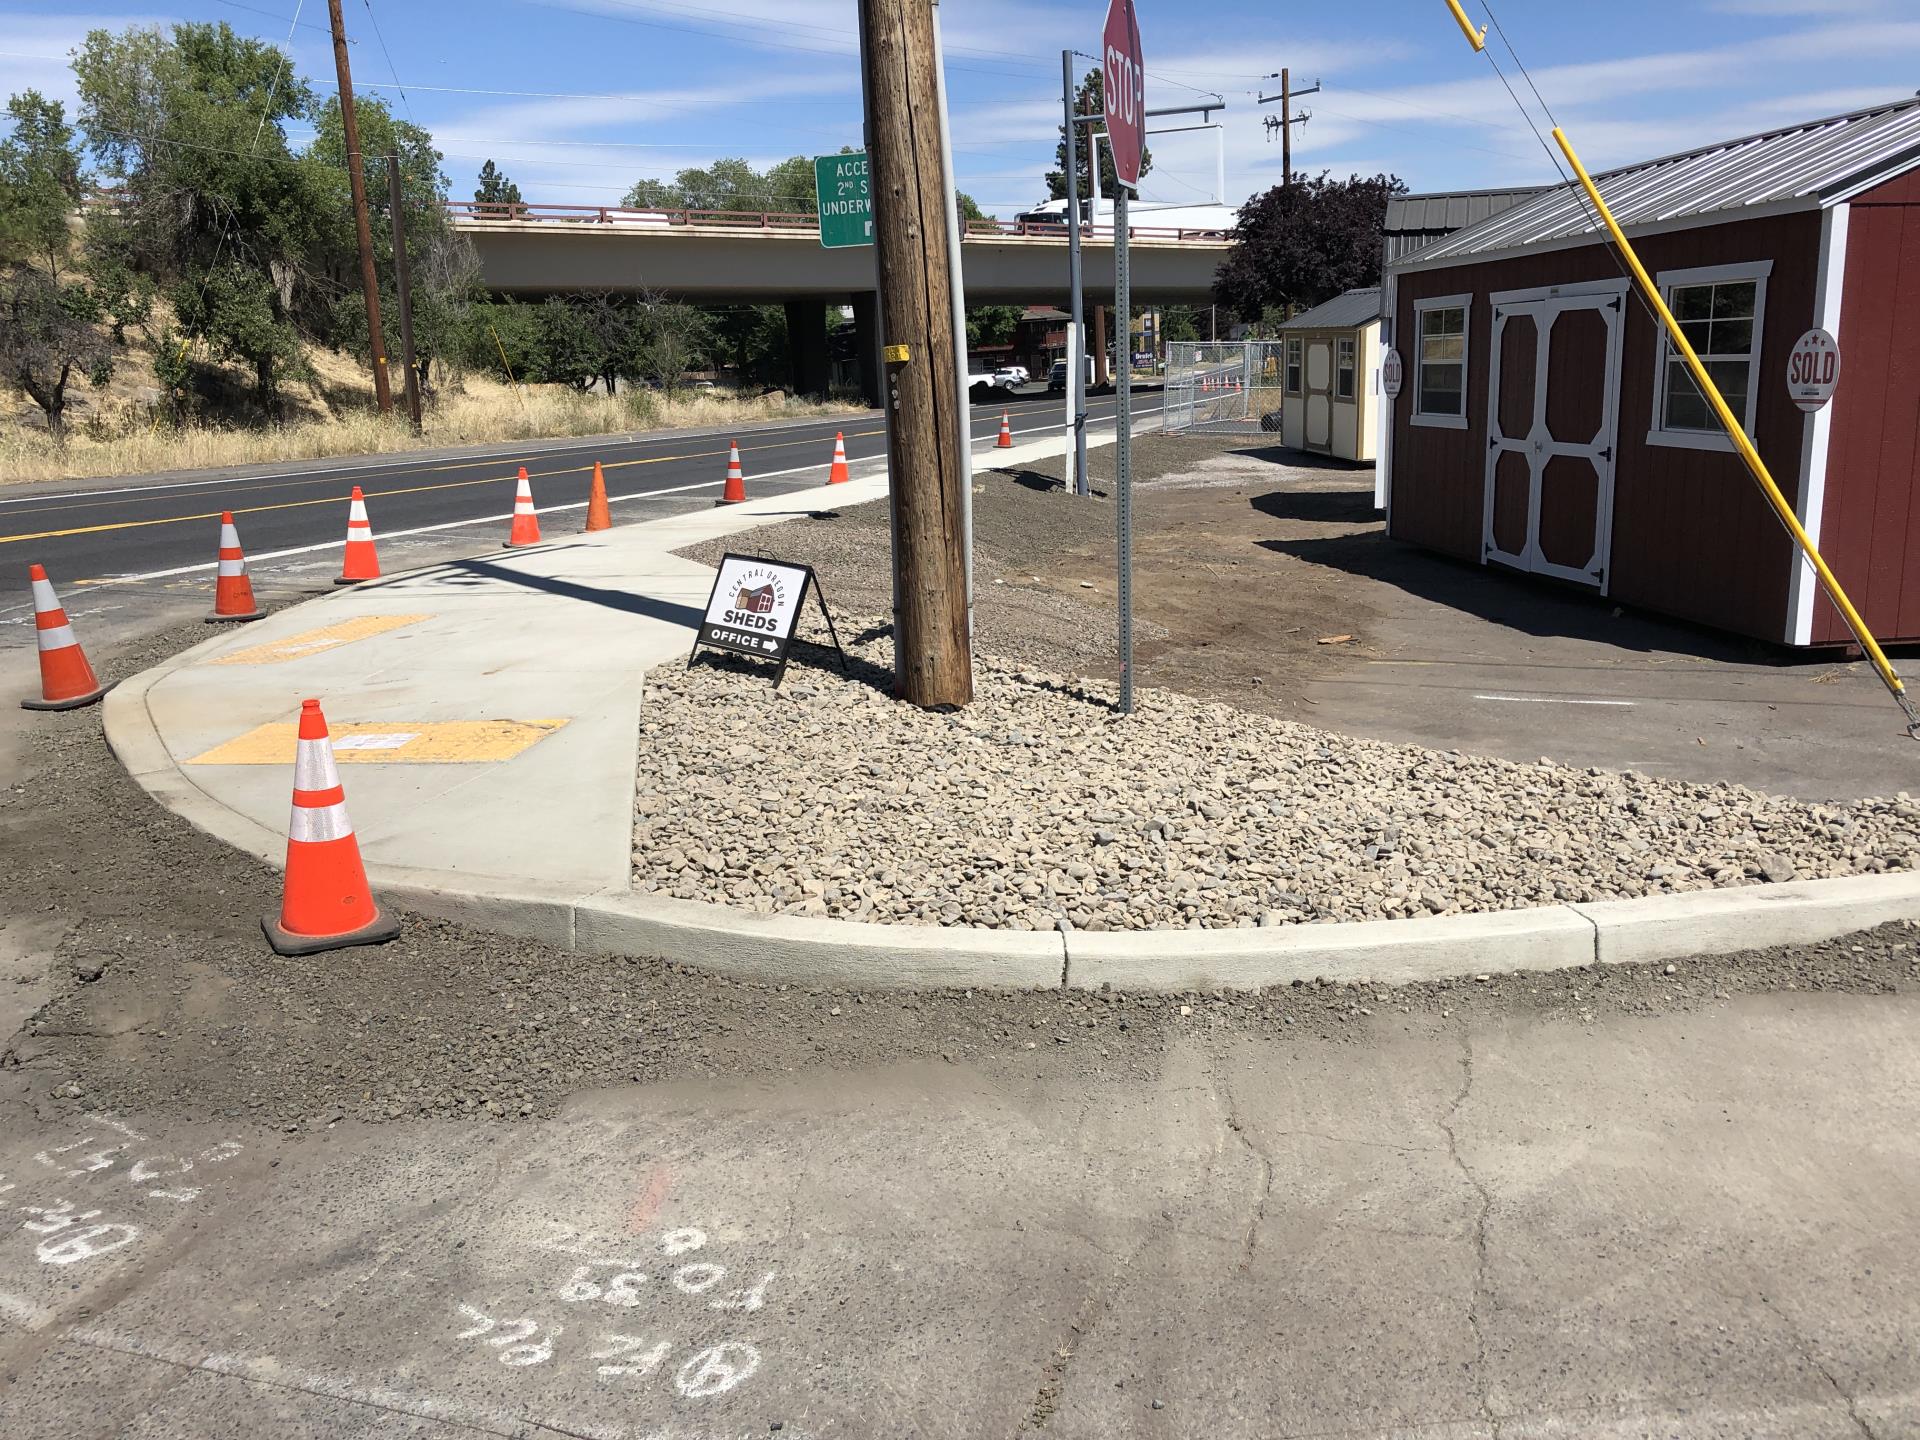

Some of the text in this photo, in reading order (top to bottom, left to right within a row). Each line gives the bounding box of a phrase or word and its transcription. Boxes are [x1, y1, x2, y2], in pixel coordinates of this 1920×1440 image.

[1106, 44, 1141, 127] STOP
[836, 160, 869, 177] ACCE
[860, 179, 868, 194] S
[822, 198, 872, 216] UNDERW
[1384, 363, 1401, 383] SOLD
[1790, 351, 1836, 385] SOLD
[728, 568, 785, 607] CENTRAL OREGON
[722, 609, 778, 632] SHEDS
[711, 629, 760, 649] OFFICE
